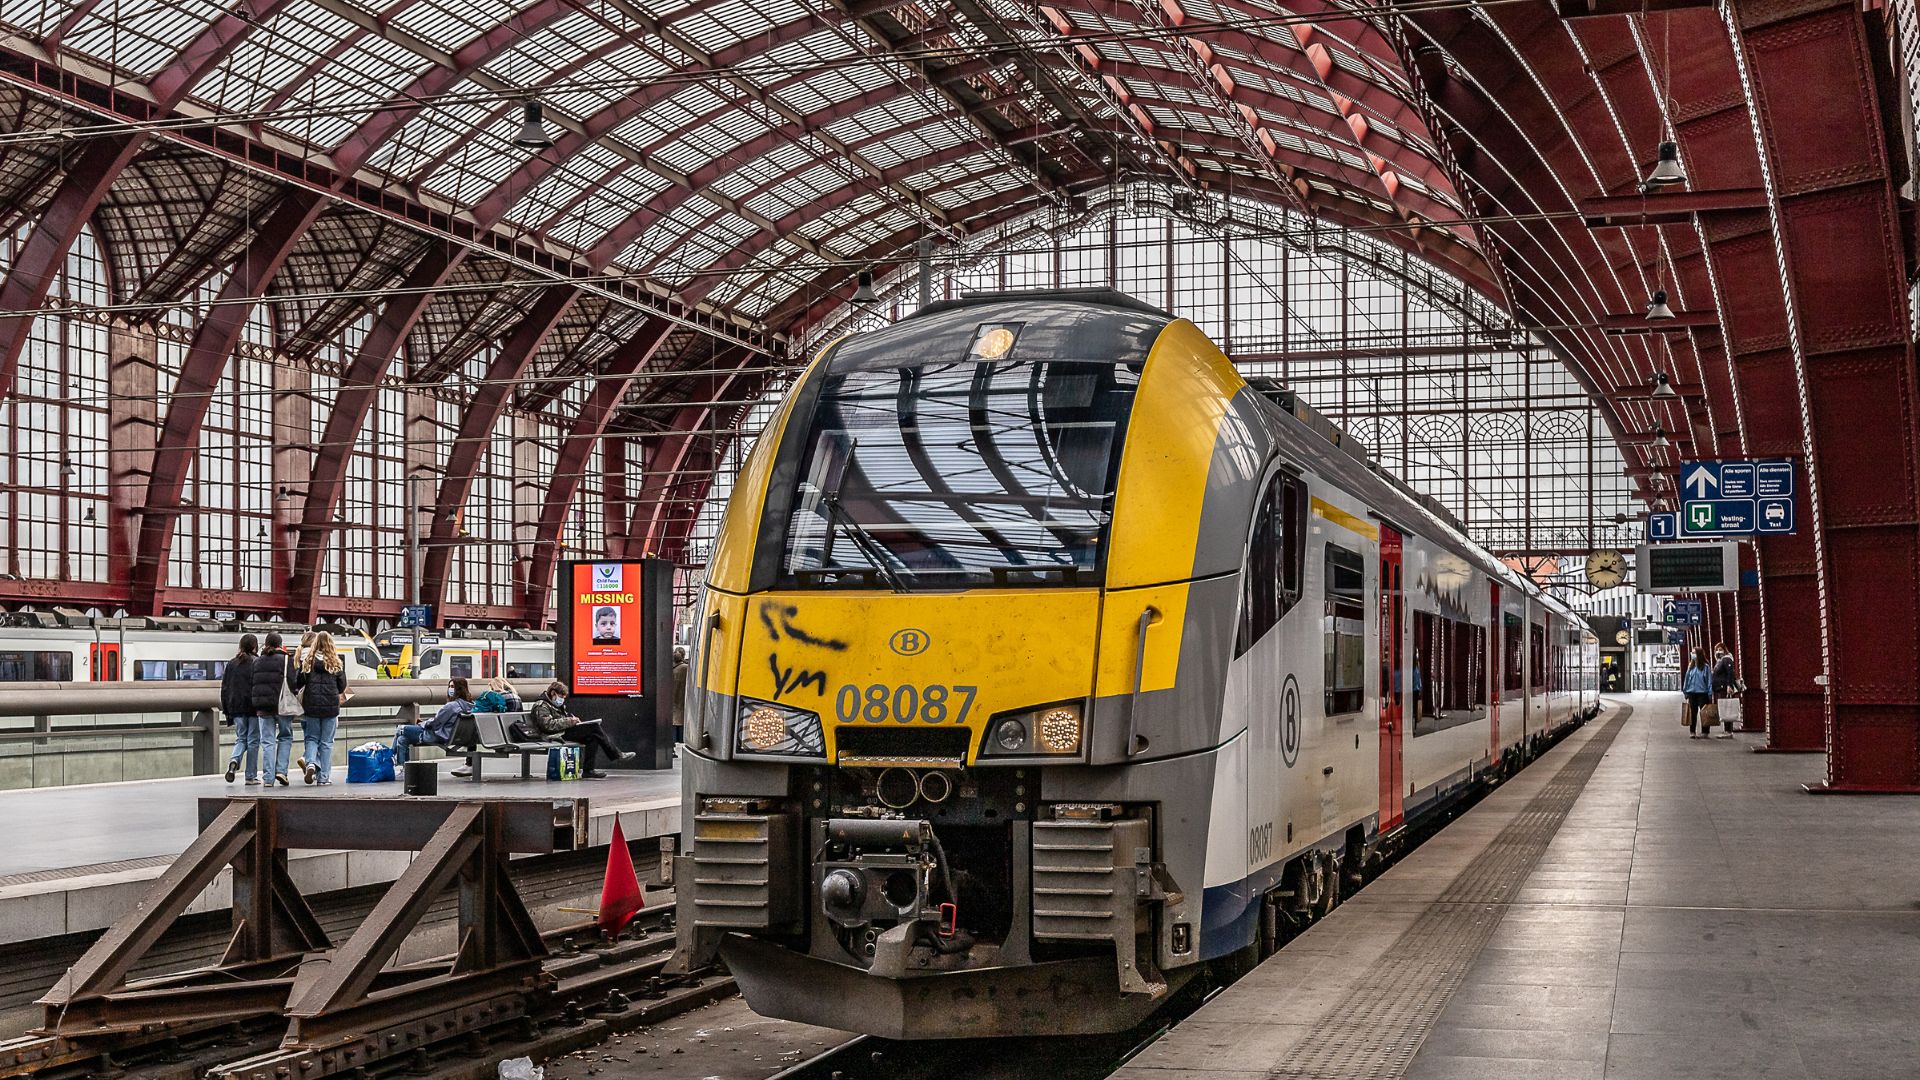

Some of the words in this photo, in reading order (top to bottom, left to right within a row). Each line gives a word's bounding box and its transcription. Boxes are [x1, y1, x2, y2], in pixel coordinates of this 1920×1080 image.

[1720, 515, 1746, 523] Vesting-
[1657, 520, 1665, 534] 1
[580, 593, 634, 604] MISSING
[83, 656, 88, 666] 2
[835, 684, 978, 724] 08087
[1249, 821, 1273, 865] 08087
